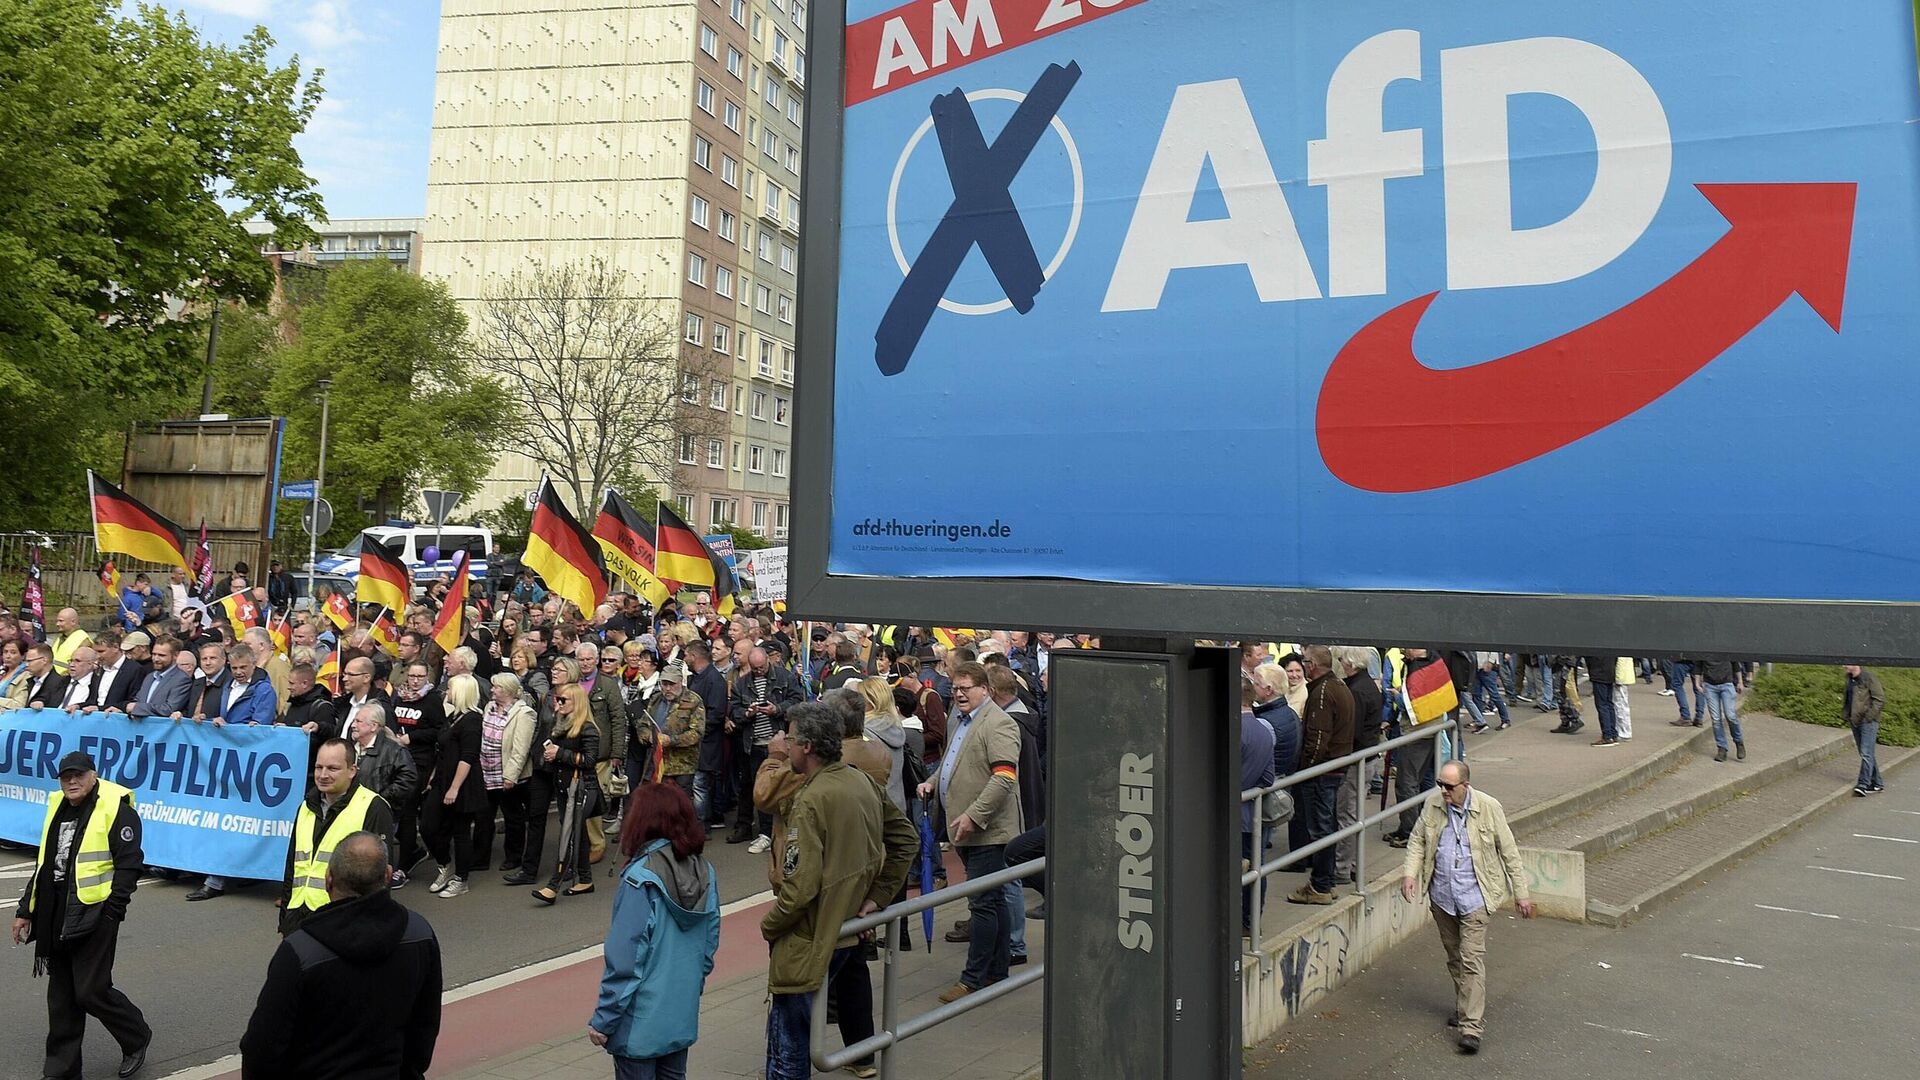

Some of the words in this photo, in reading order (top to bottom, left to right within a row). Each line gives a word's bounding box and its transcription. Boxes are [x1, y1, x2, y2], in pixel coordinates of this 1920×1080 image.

[872, 0, 1003, 90] AM
[1100, 29, 1673, 313] AfD
[617, 530, 635, 552] WIR
[634, 545, 655, 565] SIN
[852, 519, 1011, 541] afd-thueringen.de
[604, 550, 624, 571] DAS
[624, 564, 652, 591] VOLK
[406, 708, 422, 720] DO
[79, 735, 292, 808] FRÜHLING
[25, 787, 46, 805] WIR
[138, 801, 201, 827] FRÜHLING
[202, 811, 219, 829] IM
[221, 813, 260, 836] OSTEN
[1115, 752, 1154, 954] STRÖER
